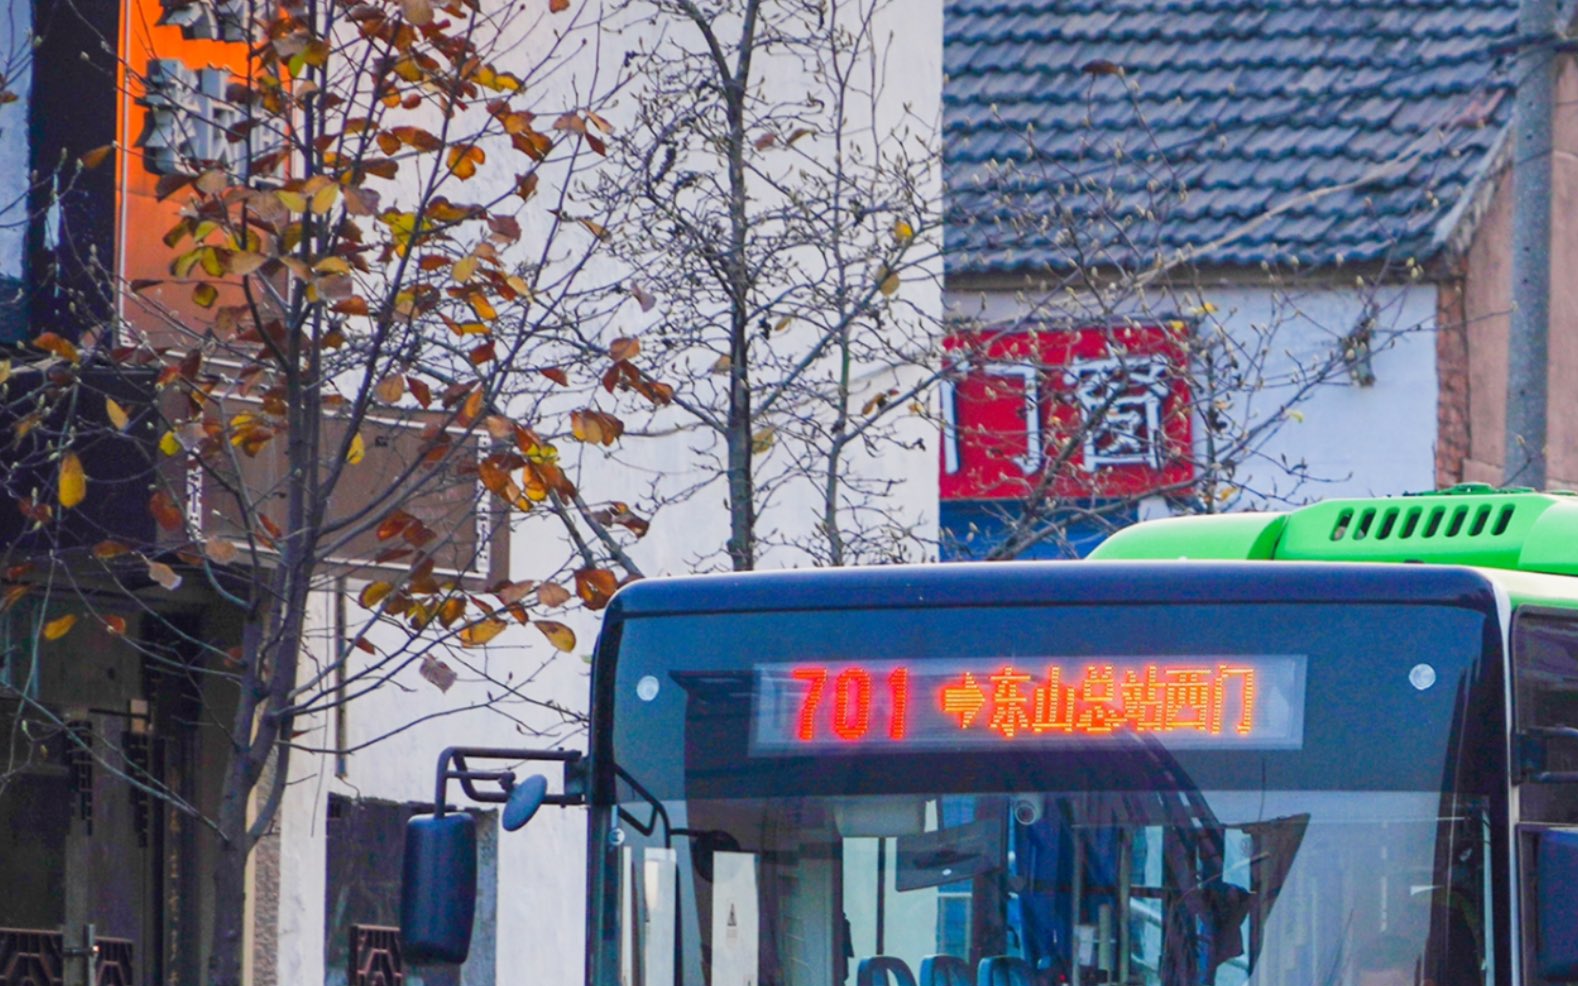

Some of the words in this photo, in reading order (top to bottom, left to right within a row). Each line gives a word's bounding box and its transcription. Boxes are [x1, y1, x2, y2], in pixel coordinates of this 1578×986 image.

[792, 666, 908, 740] 701
[989, 664, 1256, 738] 东山总站西门
